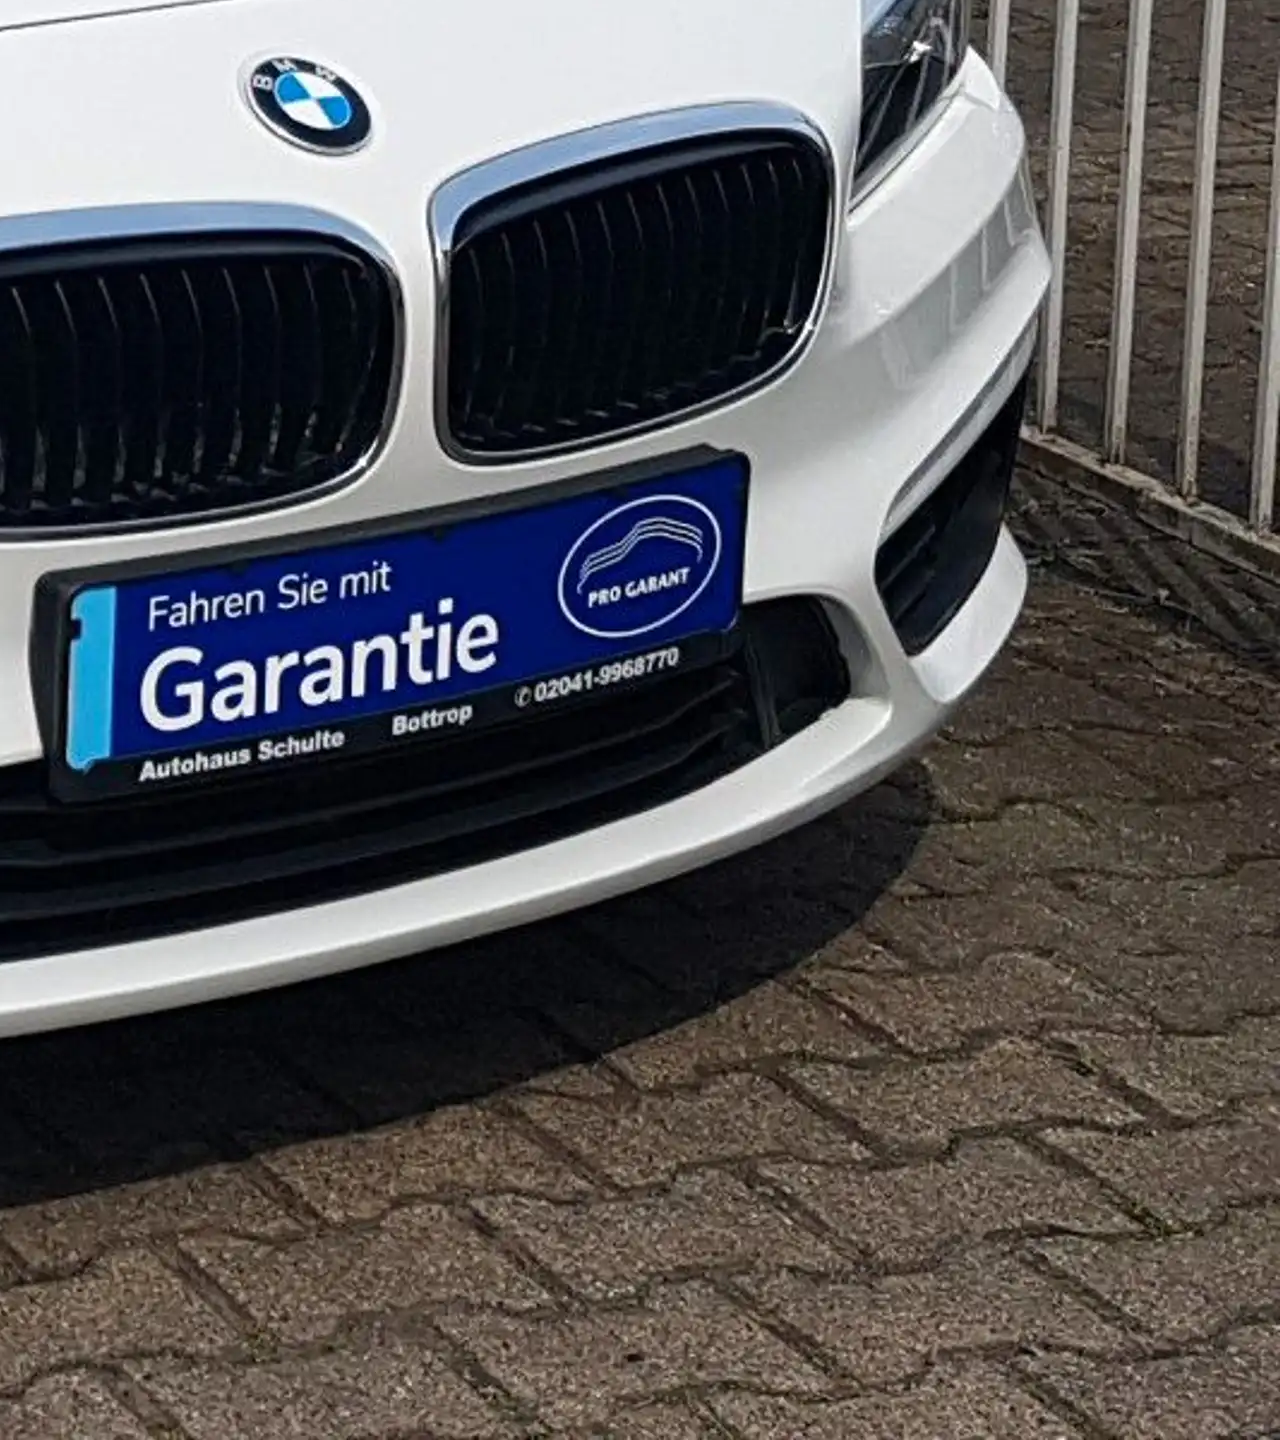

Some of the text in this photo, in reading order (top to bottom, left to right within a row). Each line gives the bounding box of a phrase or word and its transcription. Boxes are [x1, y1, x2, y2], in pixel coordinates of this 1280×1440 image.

[148, 560, 392, 632] Fahren Sie mit
[588, 567, 691, 609] PRO GARANT
[139, 597, 499, 733] Garantie
[139, 646, 680, 782] Autohaus Schulte Bottrop 02041-9968770
